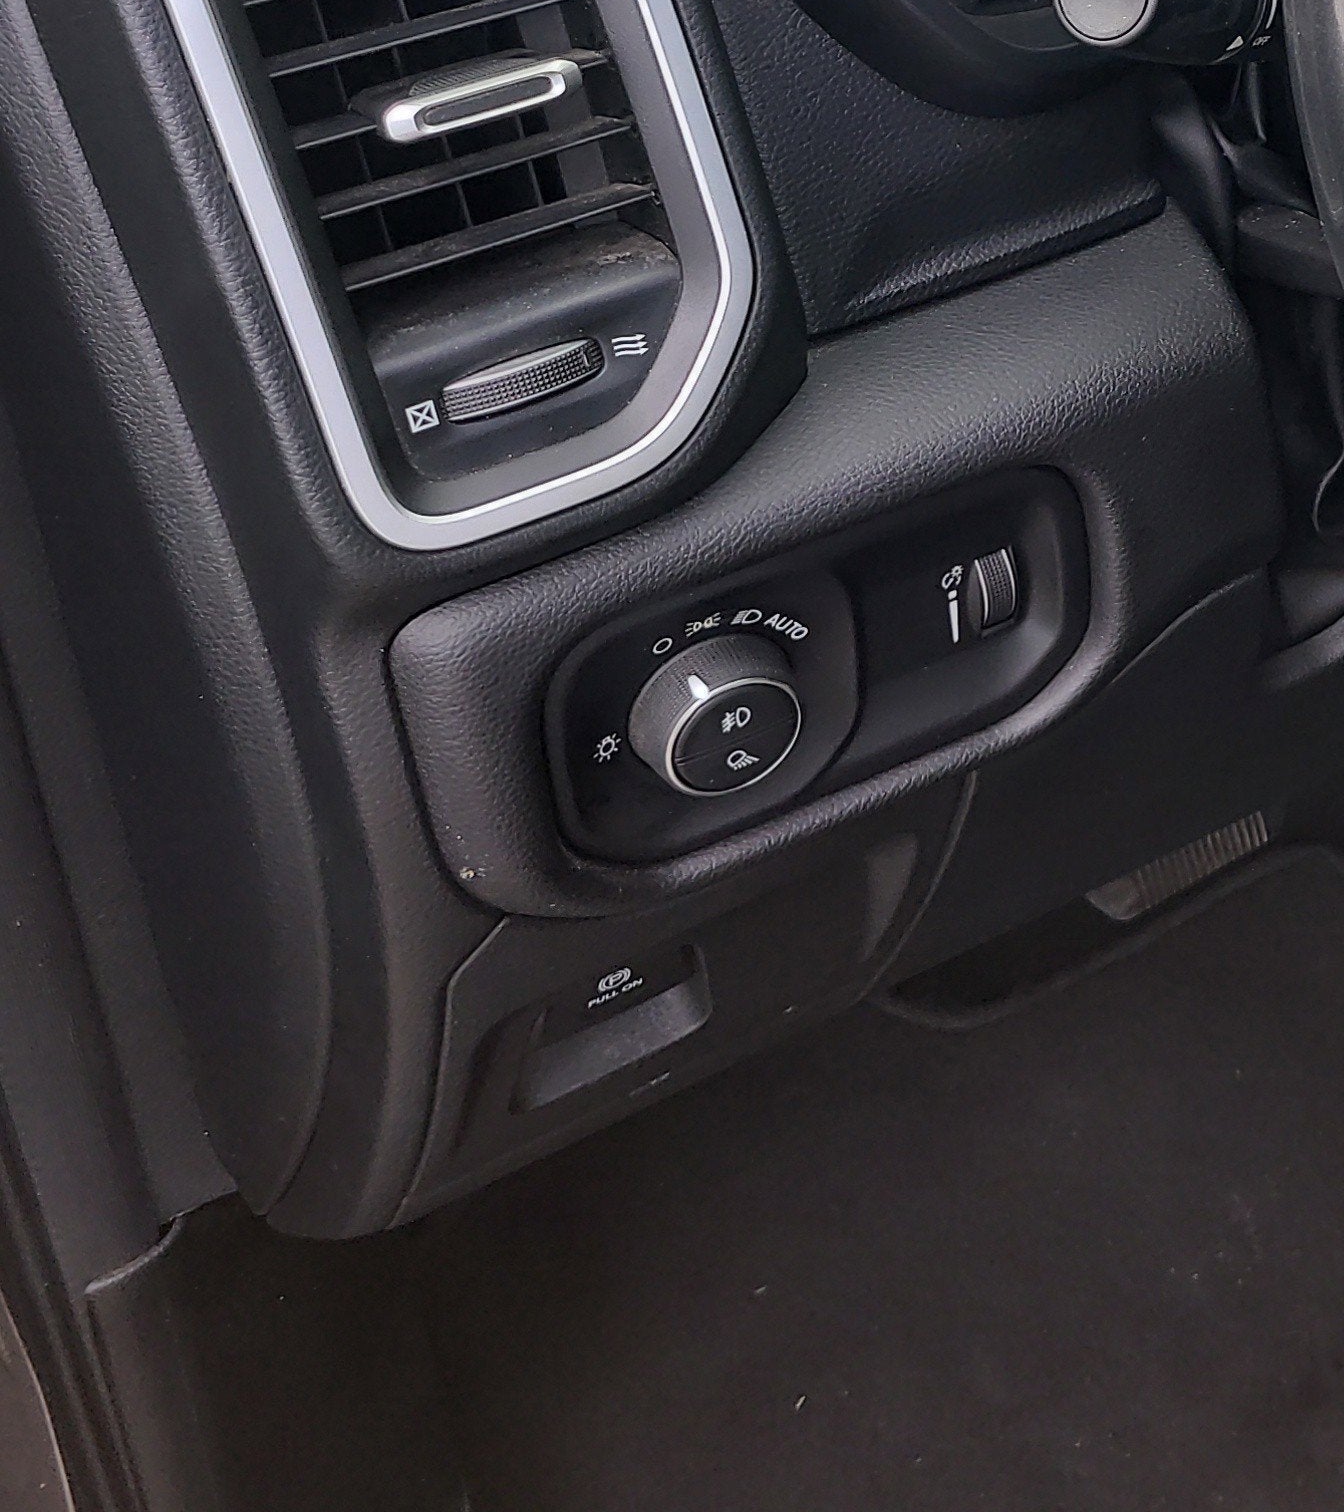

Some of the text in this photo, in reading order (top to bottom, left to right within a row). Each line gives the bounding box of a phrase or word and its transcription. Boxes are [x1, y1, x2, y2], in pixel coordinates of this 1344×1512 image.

[763, 613, 809, 641] AUTO
[588, 977, 643, 1009] PULL ON
